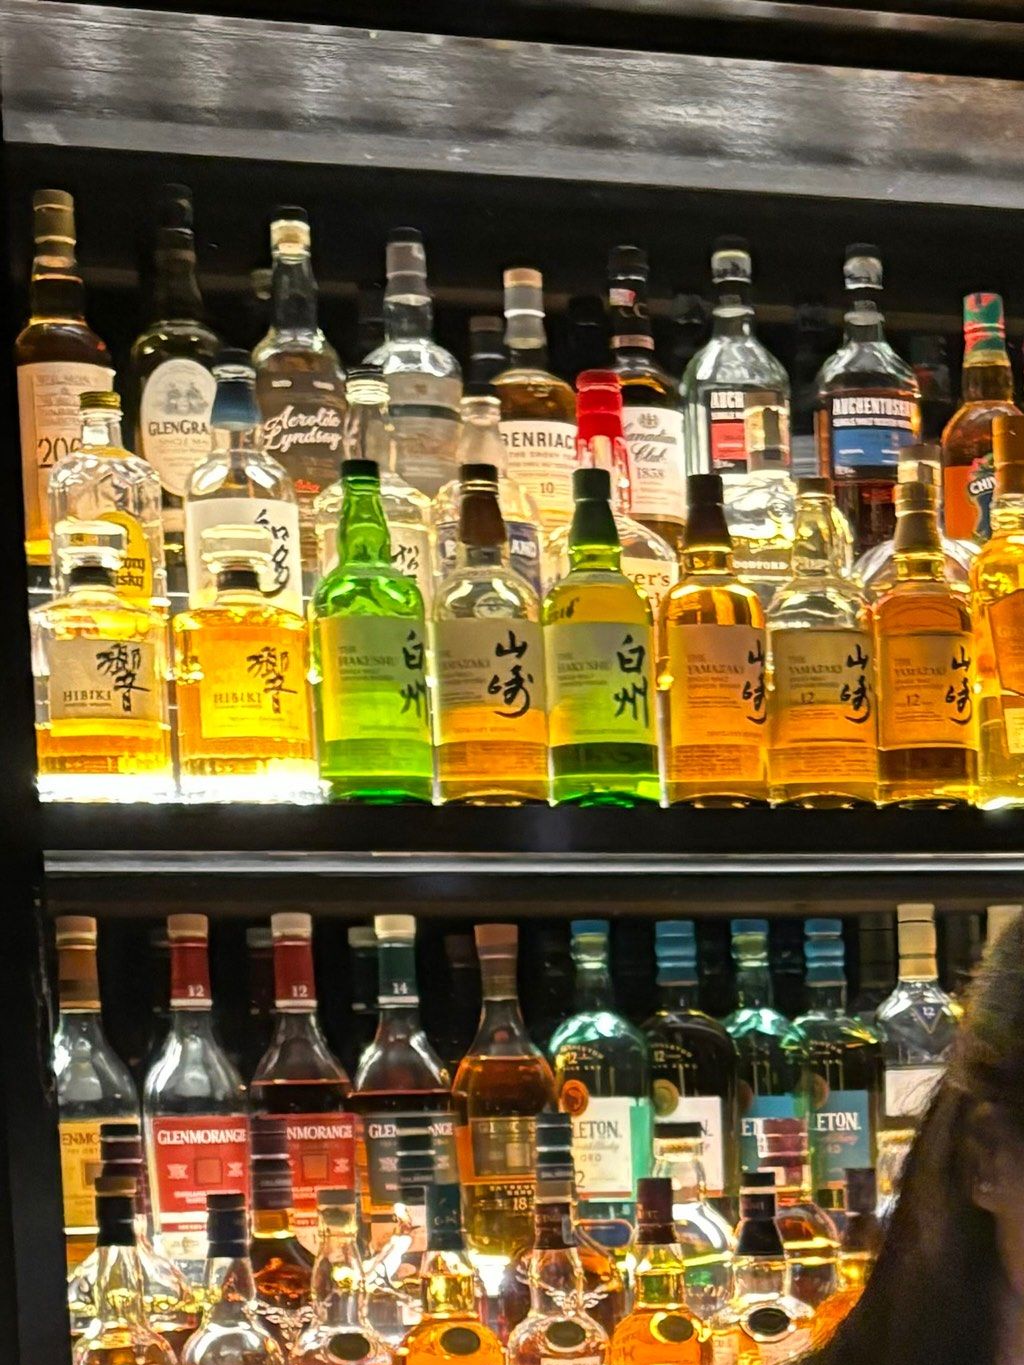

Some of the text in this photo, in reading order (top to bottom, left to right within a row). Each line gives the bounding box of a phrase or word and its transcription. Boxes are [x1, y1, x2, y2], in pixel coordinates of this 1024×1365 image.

[149, 419, 209, 436] GLENGRA
[540, 482, 554, 494] 10
[613, 634, 649, 728] 白州
[63, 690, 111, 701] HIBIKI
[213, 692, 263, 704] HIBIKI
[801, 692, 815, 704] 12
[906, 694, 920, 706] 12
[187, 986, 204, 998] 12
[291, 986, 308, 998] 12
[391, 982, 408, 995] 14
[286, 1125, 354, 1140] NMORANGIE
[513, 1196, 528, 1211] 18
